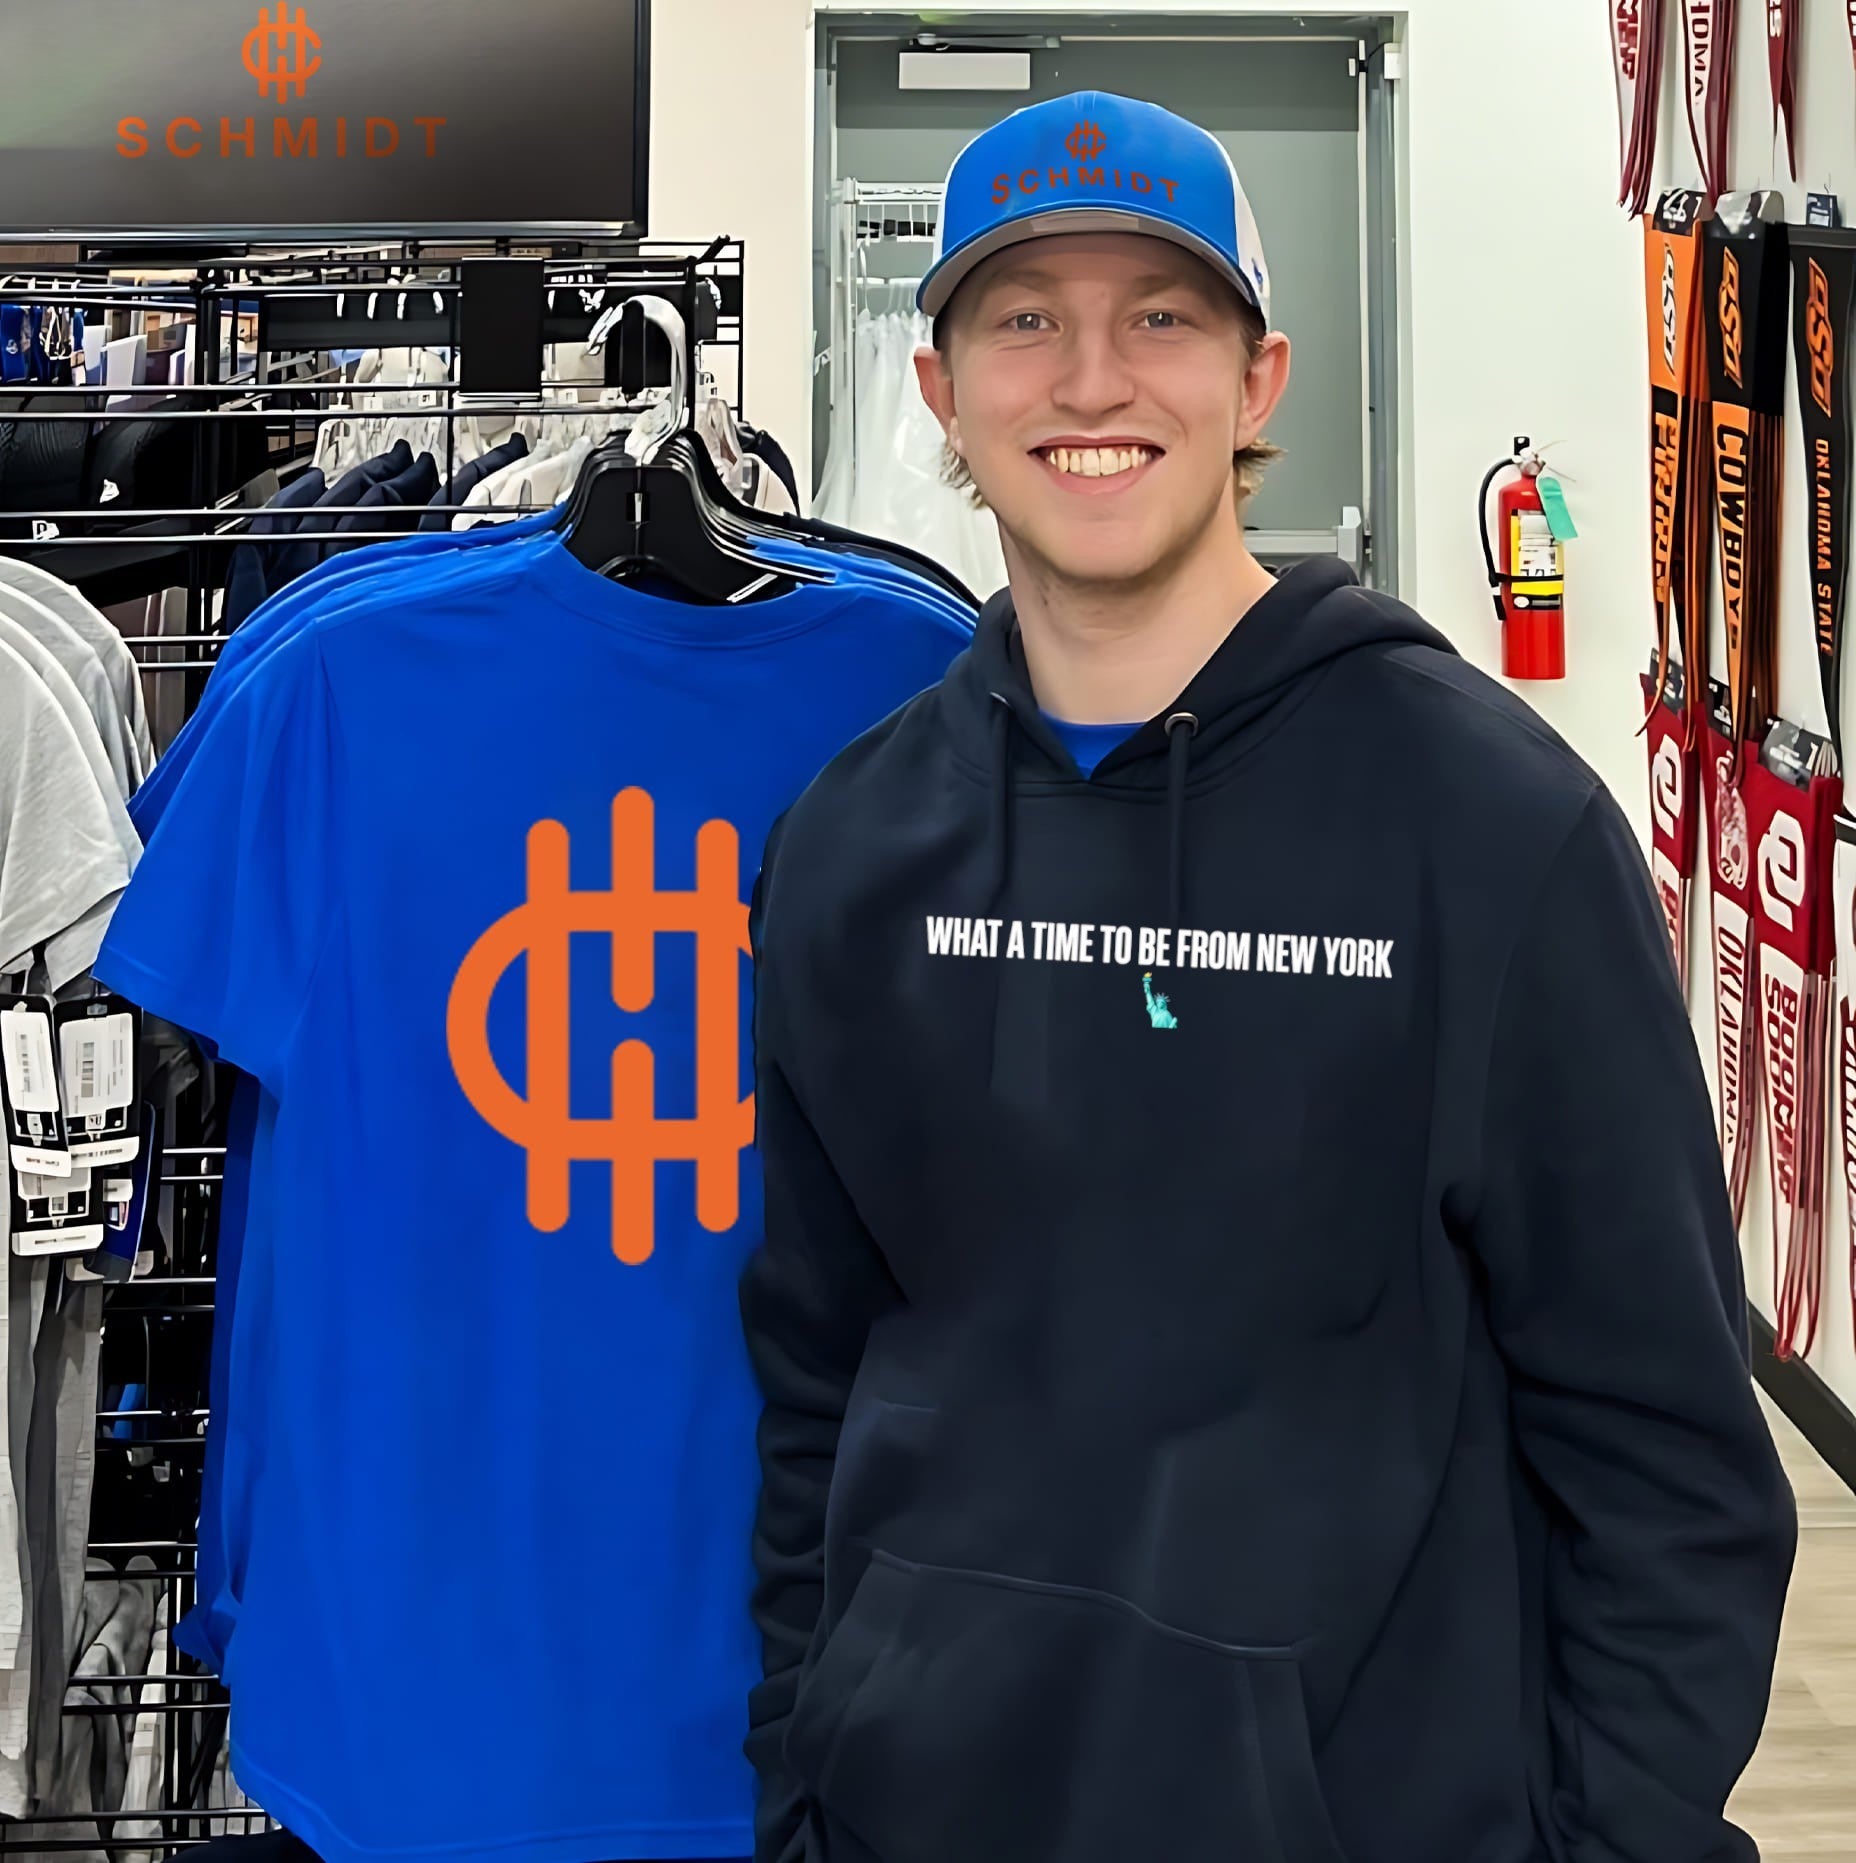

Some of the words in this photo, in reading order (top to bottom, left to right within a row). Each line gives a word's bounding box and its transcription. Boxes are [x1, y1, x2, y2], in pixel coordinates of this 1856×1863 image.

[115, 116, 448, 159] SCHMIDT
[991, 167, 1179, 205] SCHMIDT
[1815, 438, 1833, 571] OKLAHOMA
[926, 915, 1003, 958] WHAT
[1006, 919, 1026, 959] A
[1031, 921, 1096, 964] TIME
[1100, 924, 1132, 965] TO
[1137, 926, 1172, 967] BE
[1176, 928, 1252, 972] FROM
[1256, 932, 1318, 975] NEW
[1323, 935, 1394, 979] YORK
